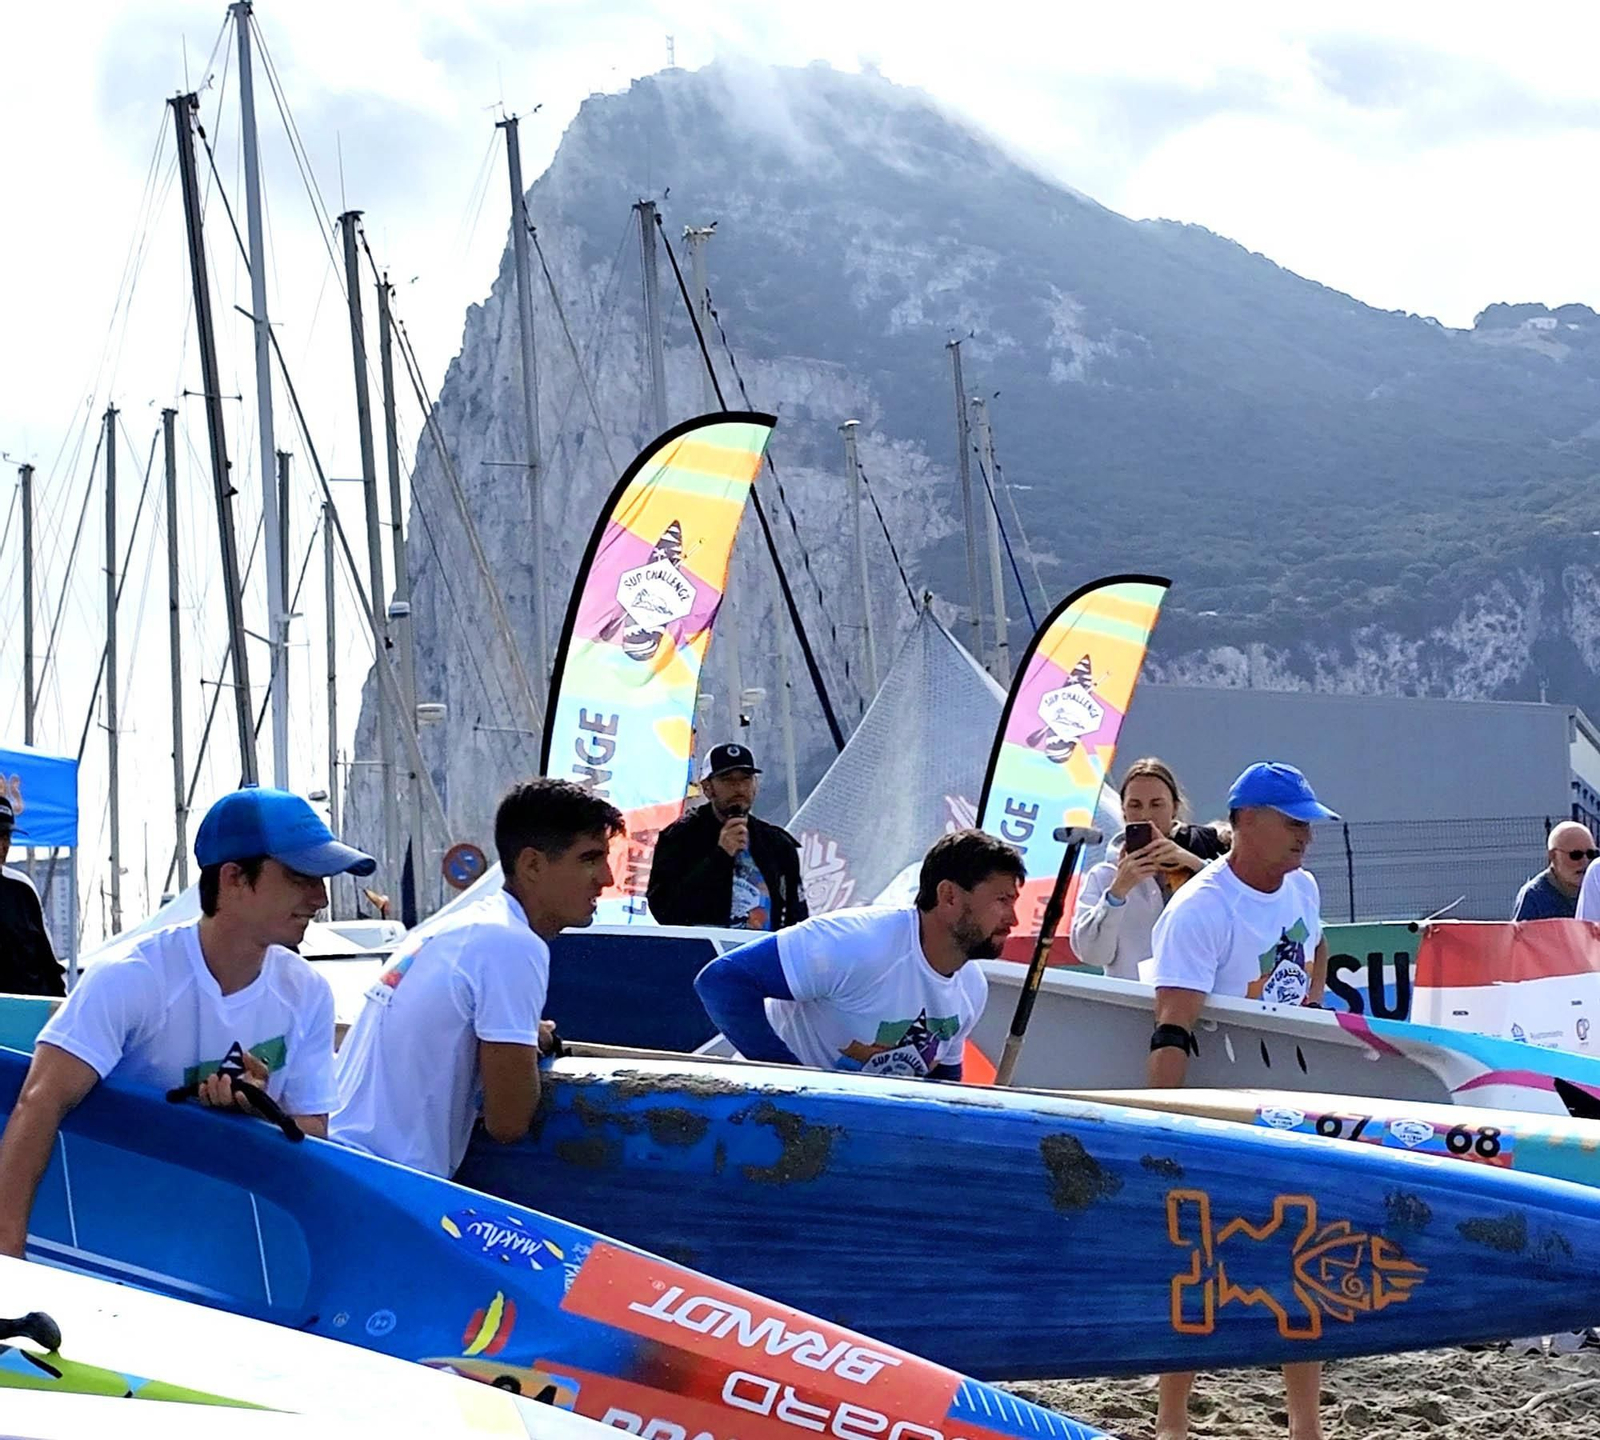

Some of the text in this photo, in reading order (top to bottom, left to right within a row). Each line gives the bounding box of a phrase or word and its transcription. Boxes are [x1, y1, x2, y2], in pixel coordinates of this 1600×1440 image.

[623, 572, 642, 590] SUP
[1326, 952, 1410, 1021] SU
[1445, 1123, 1501, 1158] 68
[628, 1286, 903, 1385] BRANDT
